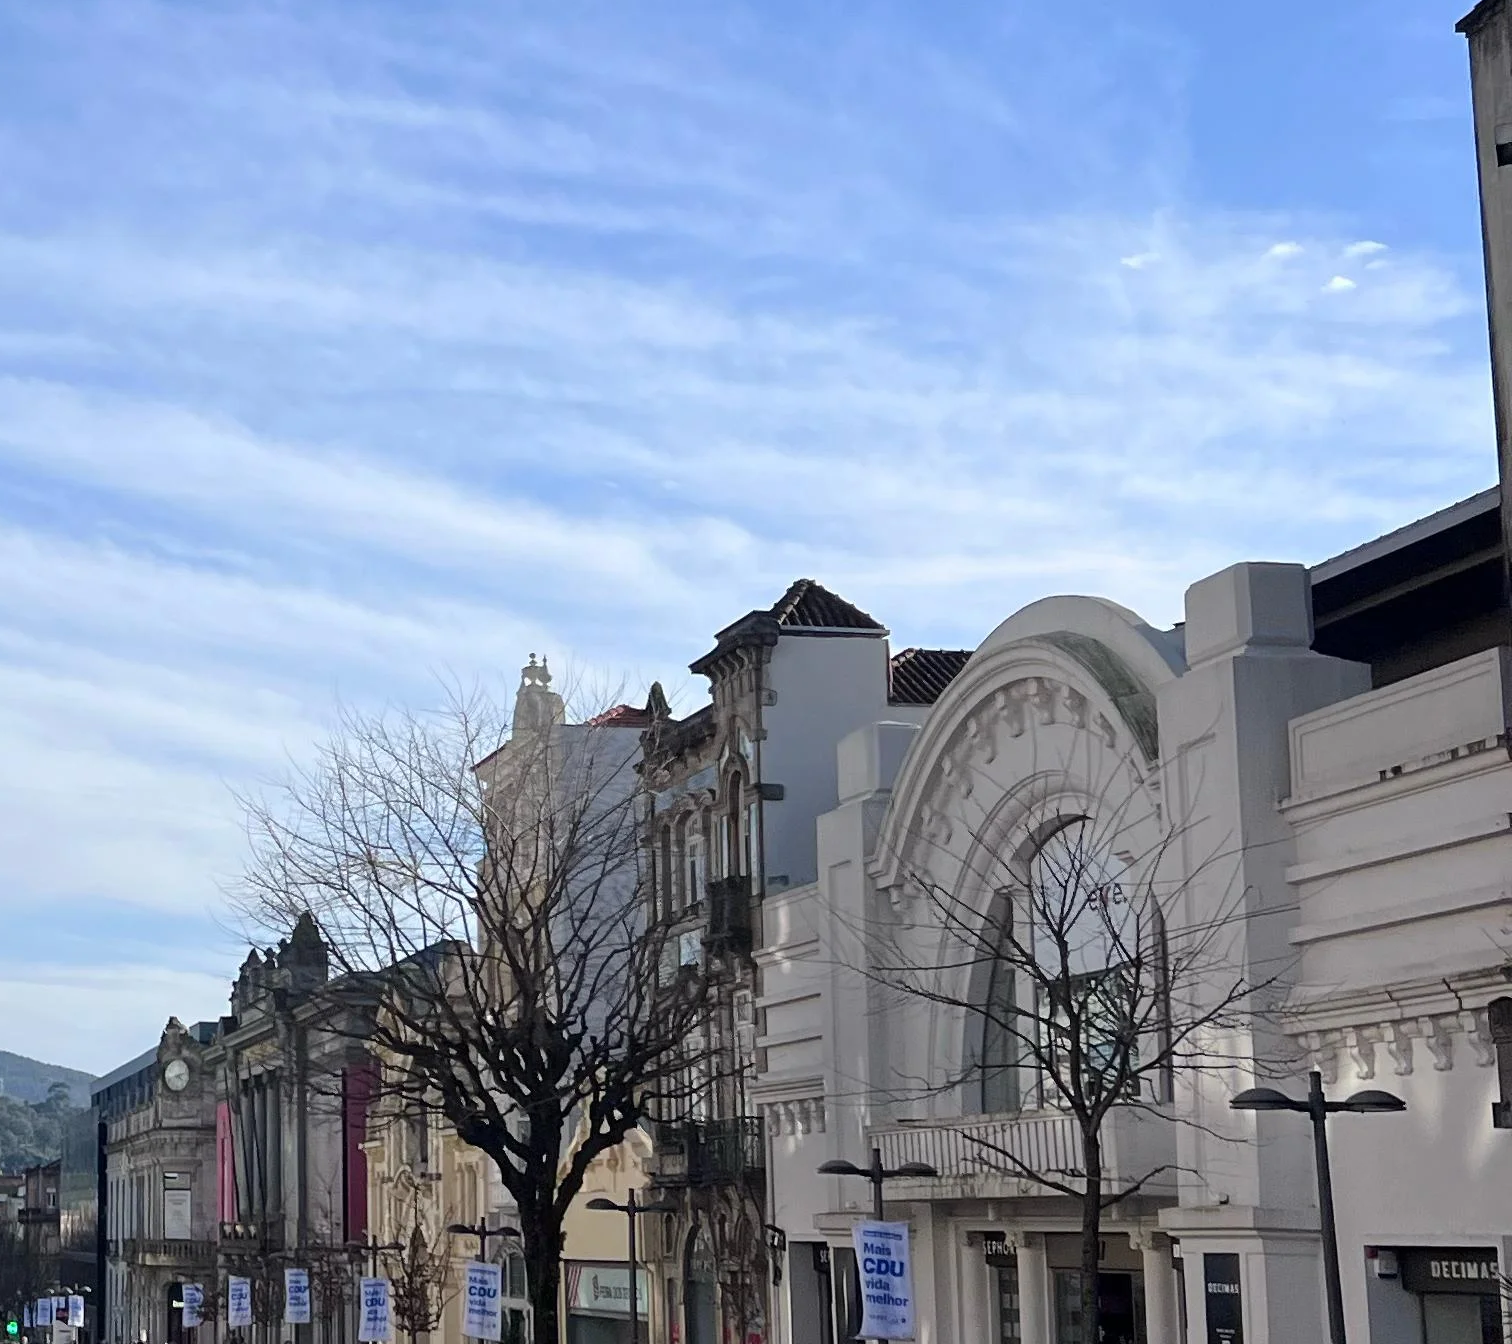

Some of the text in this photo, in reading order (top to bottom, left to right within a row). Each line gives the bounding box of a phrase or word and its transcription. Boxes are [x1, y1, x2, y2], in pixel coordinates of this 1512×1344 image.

[863, 1243, 891, 1256] Mais
[863, 1258, 904, 1277] CDU
[1431, 1261, 1500, 1279] DECIMAS
[469, 1286, 496, 1298] CDU
[865, 1279, 890, 1292] vida
[866, 1294, 908, 1306] melhor
